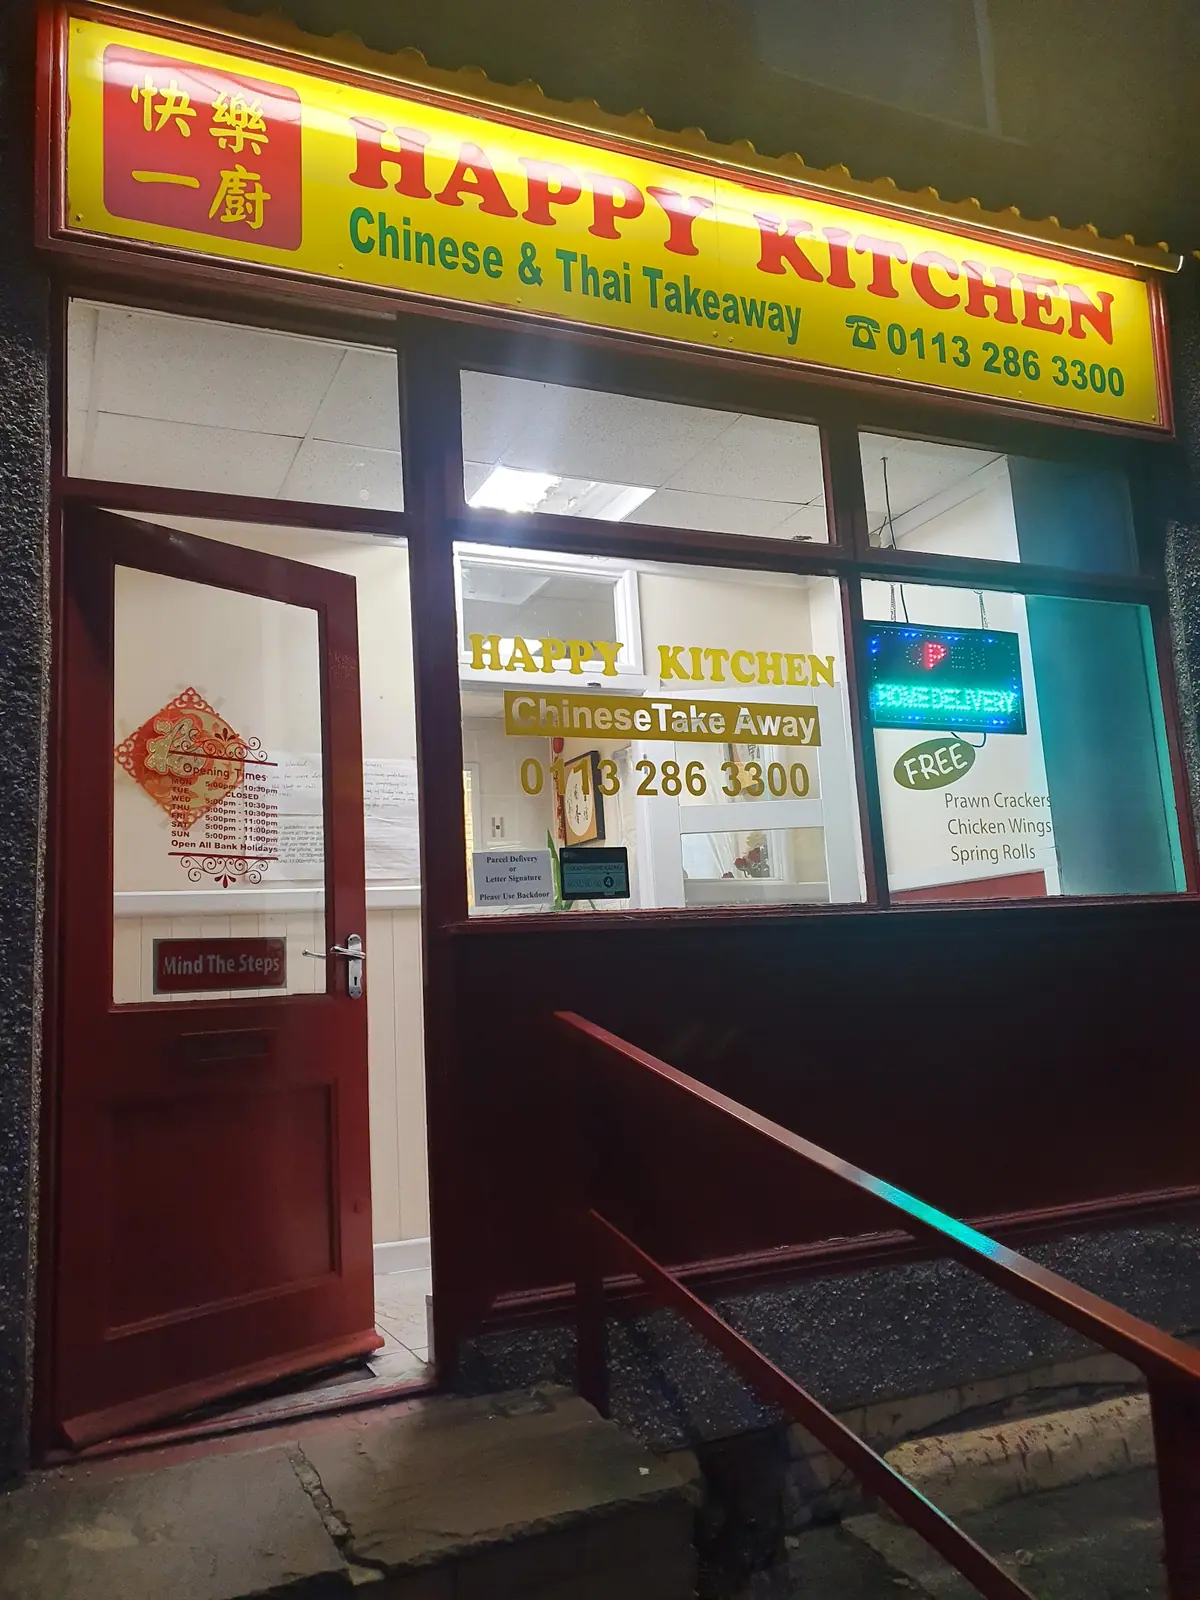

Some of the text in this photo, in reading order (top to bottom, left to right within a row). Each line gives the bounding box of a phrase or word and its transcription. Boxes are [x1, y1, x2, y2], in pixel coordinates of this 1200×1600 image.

[130, 74, 269, 156] 快樂
[348, 116, 1115, 345] HAPPY KITCHEN
[349, 207, 801, 345] Chinese & Thai Takeaway
[887, 324, 1124, 397] 0113 286 3300
[469, 633, 835, 688] HAPPY KITCHEN
[905, 642, 986, 669] OPEN
[931, 687, 1017, 714] DELIVERY
[733, 706, 815, 744] Away
[183, 763, 267, 781] Opening Times
[904, 743, 968, 785] FREE
[520, 757, 810, 797] 0113 286 3300
[171, 786, 190, 794] TUE
[225, 791, 259, 800] CLOSED
[244, 785, 278, 794] 10:30pm
[171, 795, 191, 803] WED
[205, 798, 236, 807] 5:00pm
[244, 802, 278, 810] 10:30pm
[944, 792, 1052, 808] Prawn Crackers
[205, 807, 236, 815] 5:00pm
[244, 810, 278, 818] 10:30pm
[205, 815, 236, 823] 5:00pm
[244, 818, 278, 826] 11:00pm
[171, 830, 190, 838] SUN
[205, 832, 236, 841] 5:00pm
[244, 835, 278, 843] 11:00pm
[205, 824, 236, 832] 5:00pm
[244, 826, 278, 835] 11:00pm
[947, 818, 1052, 837] Chicken Wings
[171, 840, 278, 854] Open All Bank Holidays
[951, 843, 1036, 865] Spring Rolls
[486, 854, 539, 864] Parcel Delivery
[508, 874, 542, 884] Signature
[479, 893, 501, 901] Please
[517, 890, 550, 899] Backdoor
[163, 954, 280, 976] Mind The Steps
